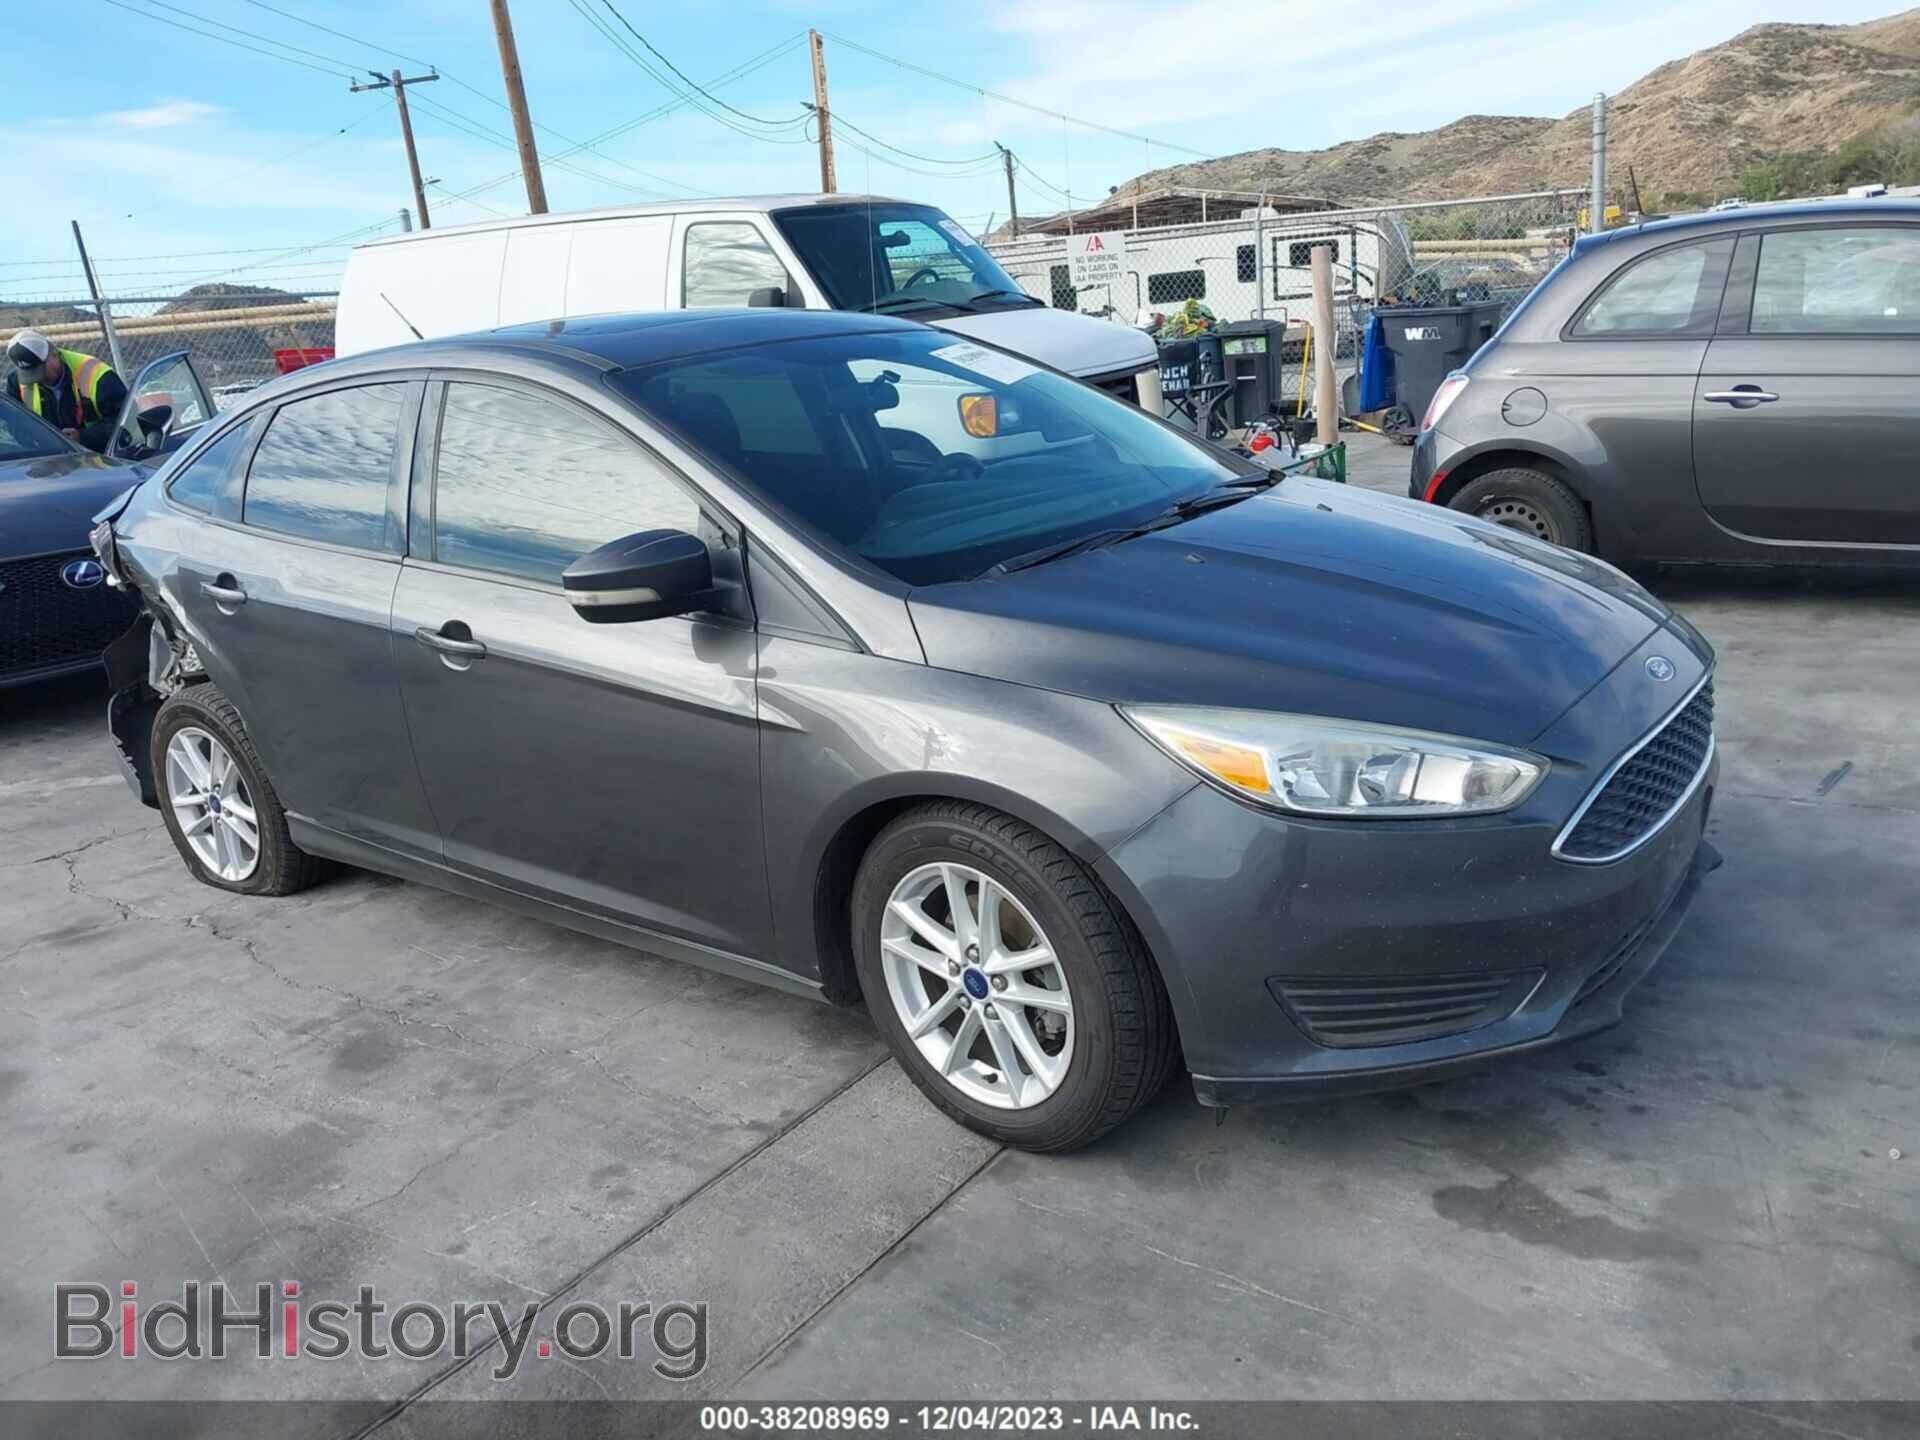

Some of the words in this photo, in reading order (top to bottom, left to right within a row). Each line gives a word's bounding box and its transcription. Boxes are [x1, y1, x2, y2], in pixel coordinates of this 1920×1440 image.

[1075, 256, 1086, 264] NO
[1087, 253, 1120, 262] WORKING
[1077, 265, 1087, 273] ON
[1089, 264, 1107, 272] CARS
[1109, 262, 1119, 270] ON
[1088, 271, 1122, 281] PROPERTY
